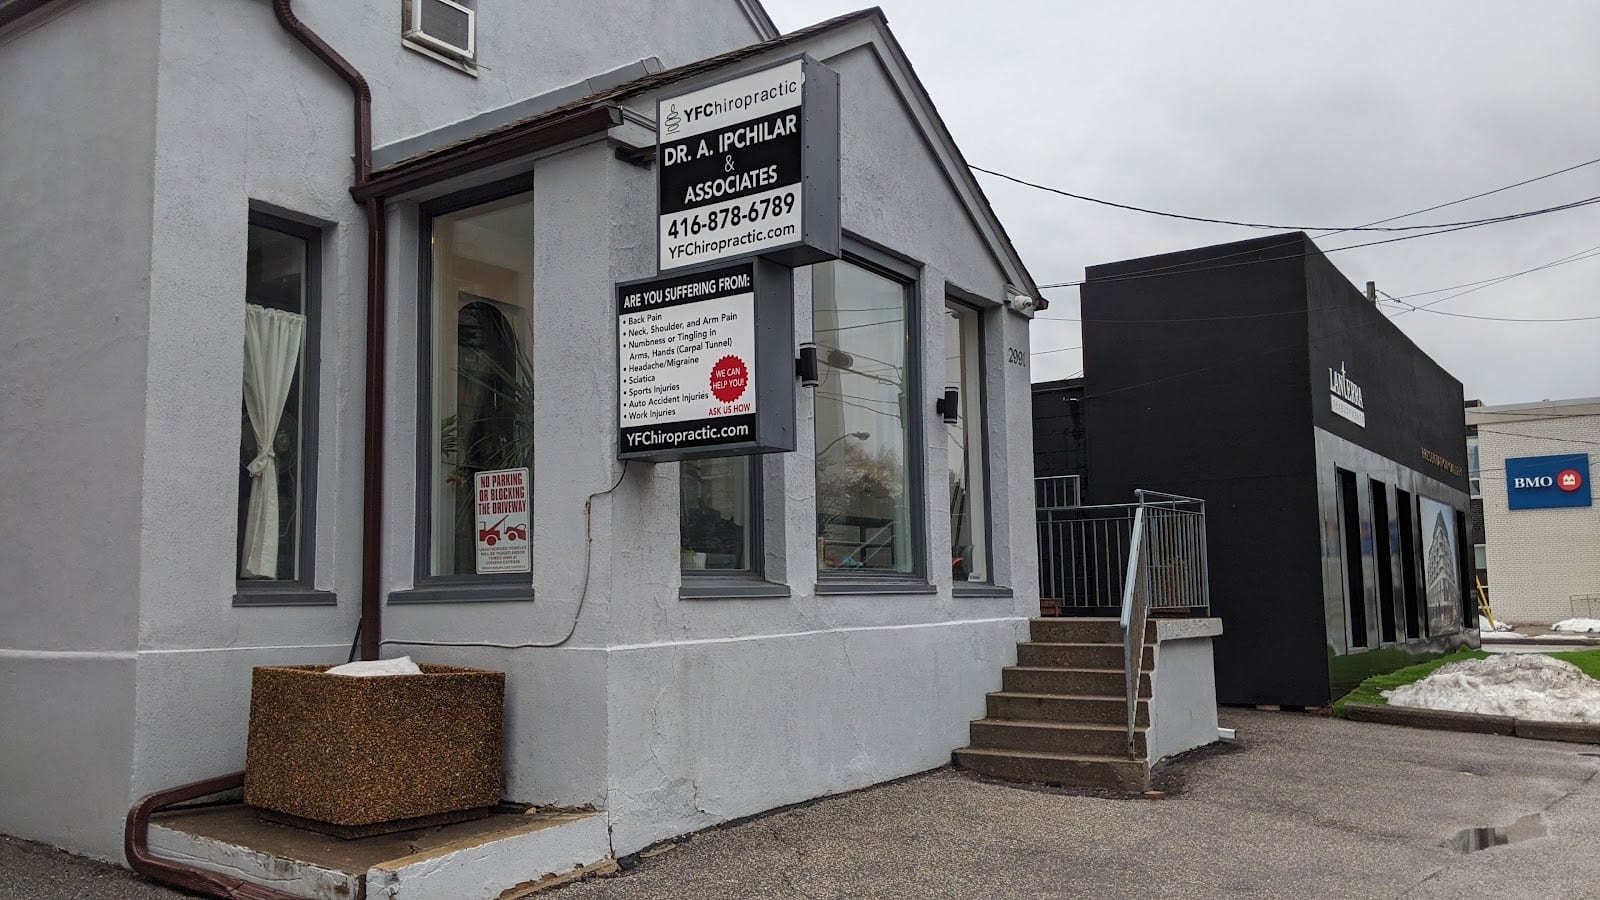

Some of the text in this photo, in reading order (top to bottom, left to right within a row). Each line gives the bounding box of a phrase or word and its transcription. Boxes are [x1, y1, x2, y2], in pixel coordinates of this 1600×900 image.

[684, 80, 797, 123] YFChiropractic
[664, 114, 797, 167] DR. A. IPCHILAR
[724, 154, 735, 173] &
[684, 165, 778, 204] ASSOCIATES
[668, 192, 795, 239] 416-878-6789
[669, 223, 795, 260] YFChiropractic.com
[623, 273, 750, 309] ARE YOU SUFFERING FROM:
[628, 313, 662, 325] Back Pain
[628, 312, 738, 337] Neck, Shoulder, and Arm Pain
[628, 328, 717, 349] Numbness or Tingling in
[629, 338, 733, 361] Arms, Hands (Carpal Tunnel)
[628, 357, 699, 373] Headache/Migraine
[715, 367, 741, 378] WE CAN
[628, 375, 656, 385] Sciatica
[712, 378, 745, 390] HELP YOU!
[628, 383, 680, 398] Sports Injuries
[628, 391, 709, 409] Auto Accident Injuries
[628, 408, 676, 420] Work Injuries
[708, 403, 751, 416] ASK US HOW
[626, 424, 749, 447] YFChiropractic.com
[480, 473, 523, 488] NO PARKING
[1513, 476, 1553, 488] BMO
[479, 486, 525, 502] OR BLOCKING
[478, 500, 527, 515] THE DRIVEWAY
